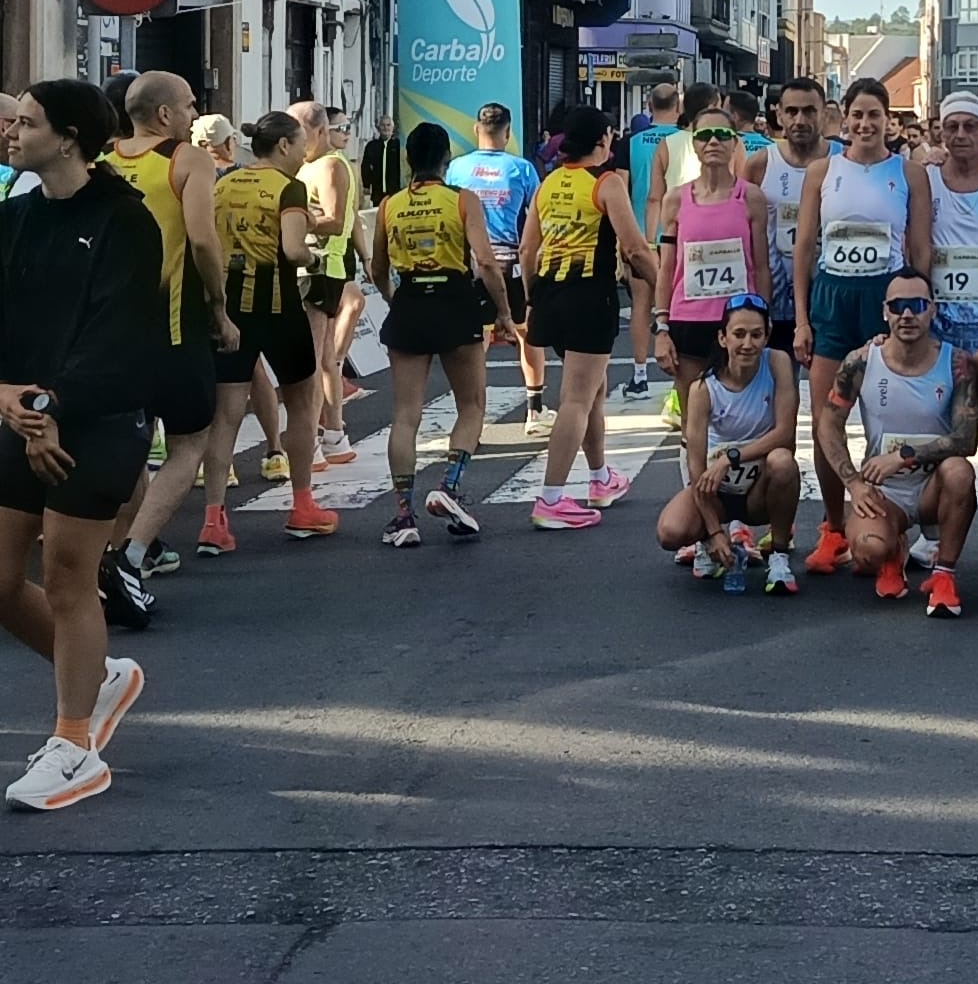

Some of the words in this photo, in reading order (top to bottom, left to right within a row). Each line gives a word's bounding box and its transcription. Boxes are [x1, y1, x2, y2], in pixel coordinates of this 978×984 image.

[411, 35, 505, 65] Carballo
[412, 64, 477, 85] Deporte
[833, 245, 878, 264] 660
[694, 266, 735, 287] 174
[944, 272, 970, 291] 19
